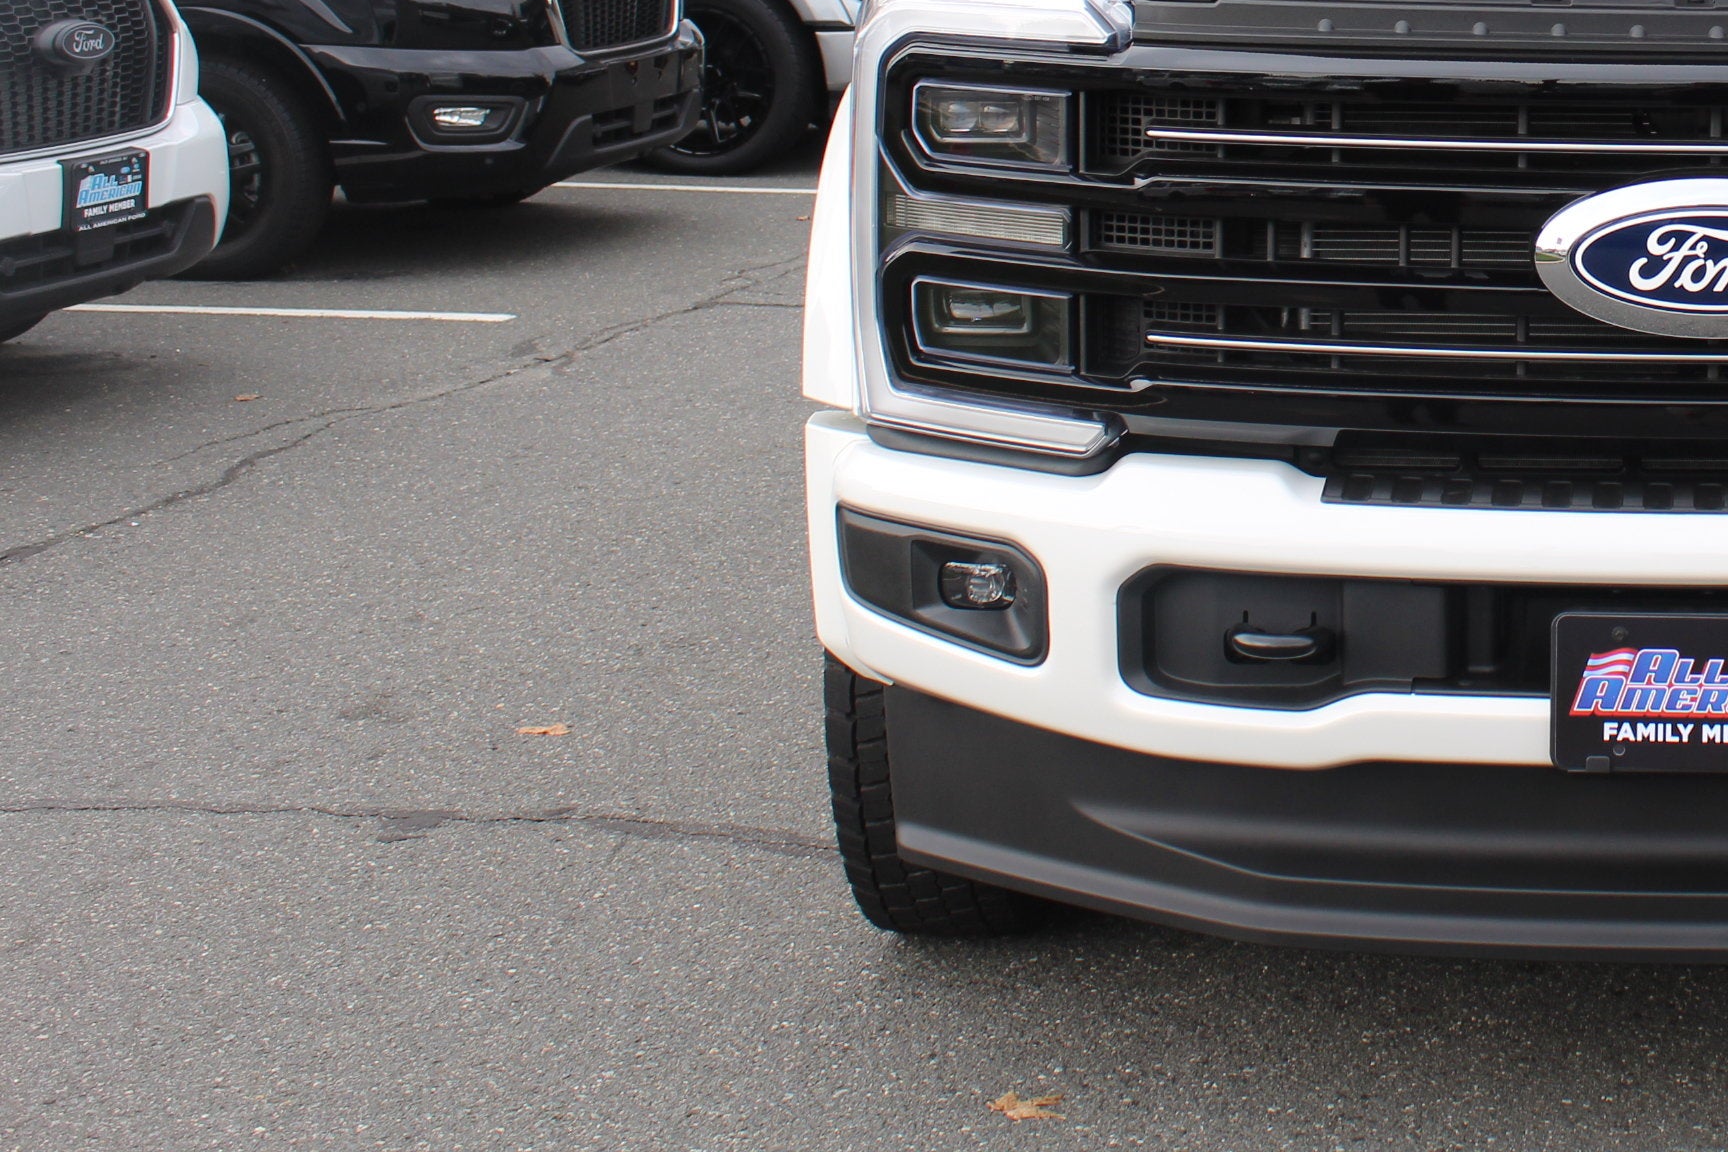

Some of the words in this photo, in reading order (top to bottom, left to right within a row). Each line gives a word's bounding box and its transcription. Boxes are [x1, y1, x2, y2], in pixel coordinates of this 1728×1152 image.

[73, 29, 104, 53] Ford
[90, 173, 119, 191] ALL
[83, 205, 108, 218] FAMILY
[109, 199, 136, 213] MEMBER
[93, 217, 127, 228] AMERICAN
[127, 212, 146, 220] FORD
[1603, 721, 1694, 743] FAMILY
